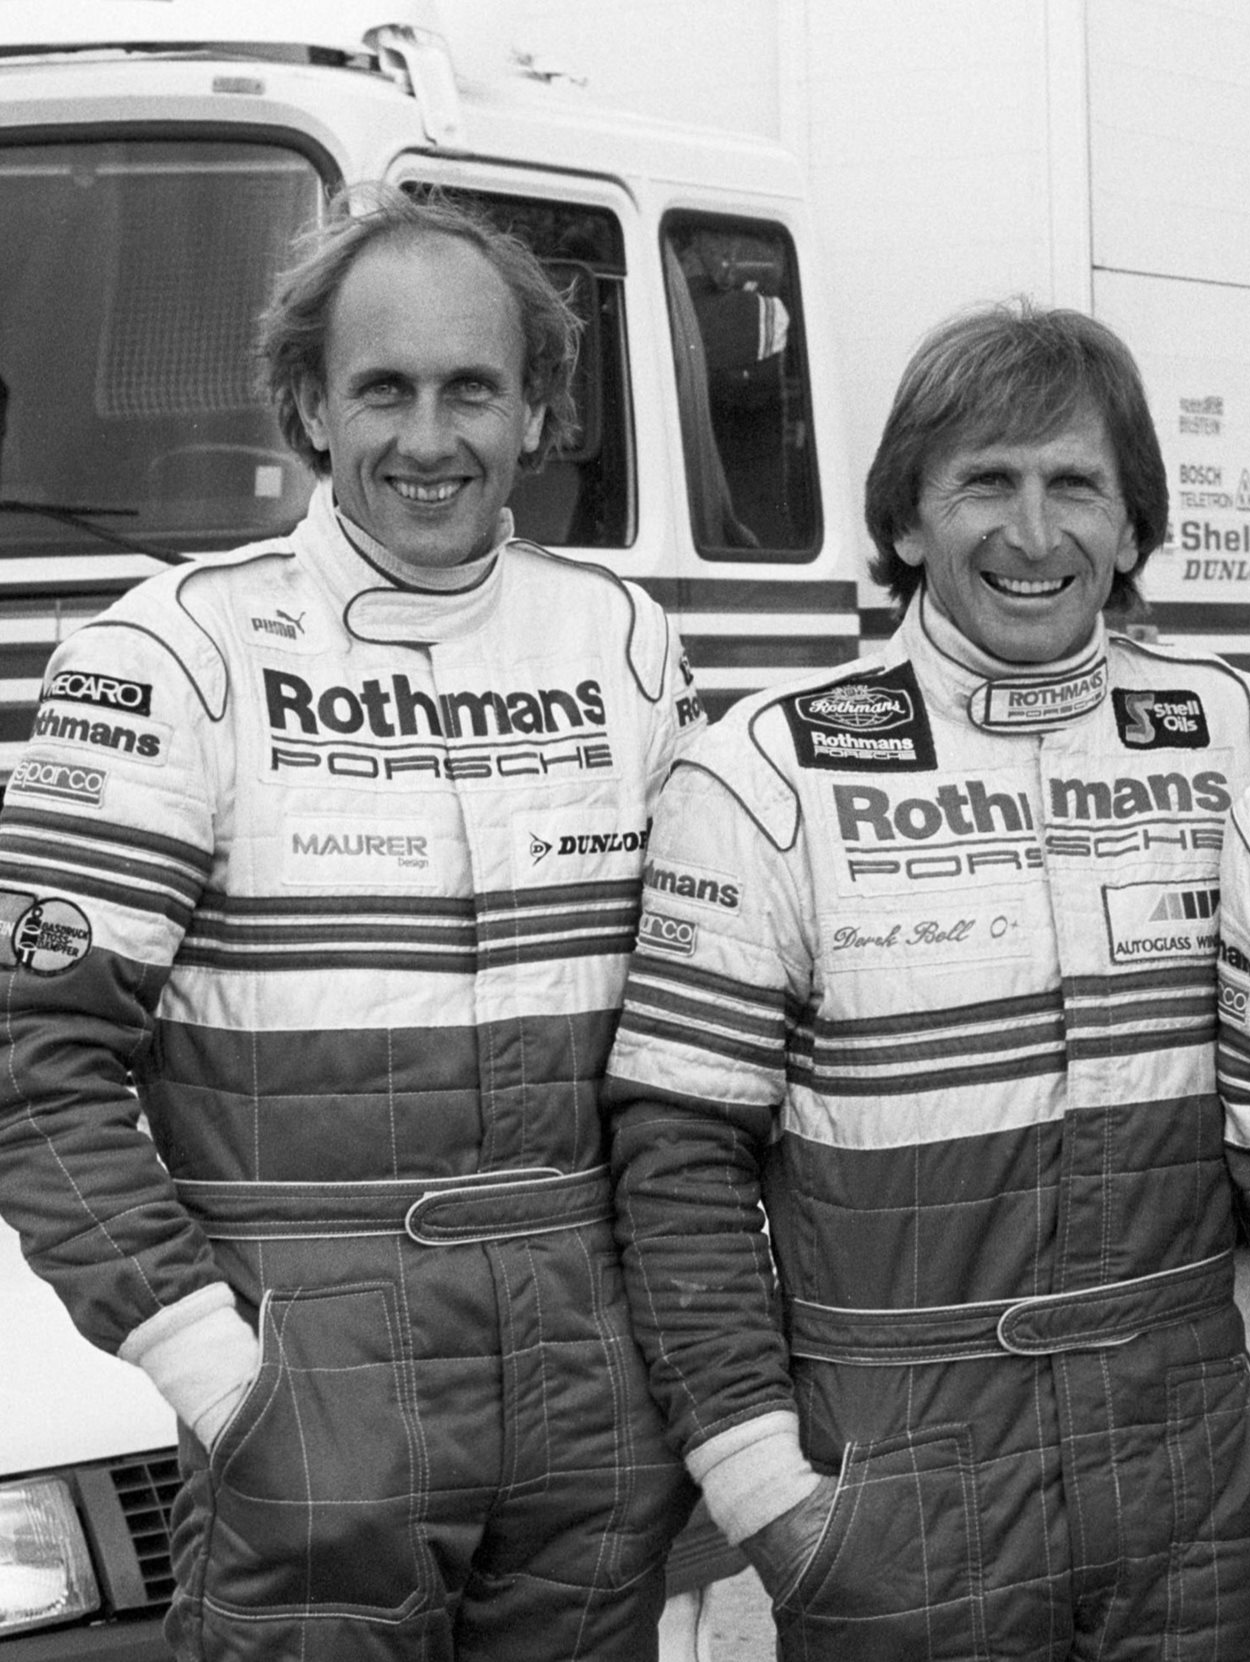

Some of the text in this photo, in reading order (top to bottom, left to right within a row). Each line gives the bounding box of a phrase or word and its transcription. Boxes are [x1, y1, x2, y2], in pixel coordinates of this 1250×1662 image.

[1179, 463, 1222, 485] BOSCH
[251, 617, 298, 641] PUMA
[1009, 671, 1103, 706] ROTHMANS
[263, 667, 606, 738] Rothmans
[809, 700, 906, 714] Rothmans
[1008, 691, 1102, 718] PORSCHE
[1153, 700, 1201, 718] Shell
[1163, 715, 1198, 733] Oils
[811, 731, 914, 750] Rothmans
[270, 743, 613, 781] PORSCHE
[814, 748, 917, 761] PORSCHE
[15, 761, 103, 793] sparco
[832, 770, 1232, 842] Rothmans
[291, 832, 429, 858] MAURER
[846, 828, 1225, 882] PORSCHE
[397, 857, 430, 869] Design
[905, 918, 976, 946] Bell
[1115, 934, 1219, 956] AUTOGLASS WIN
